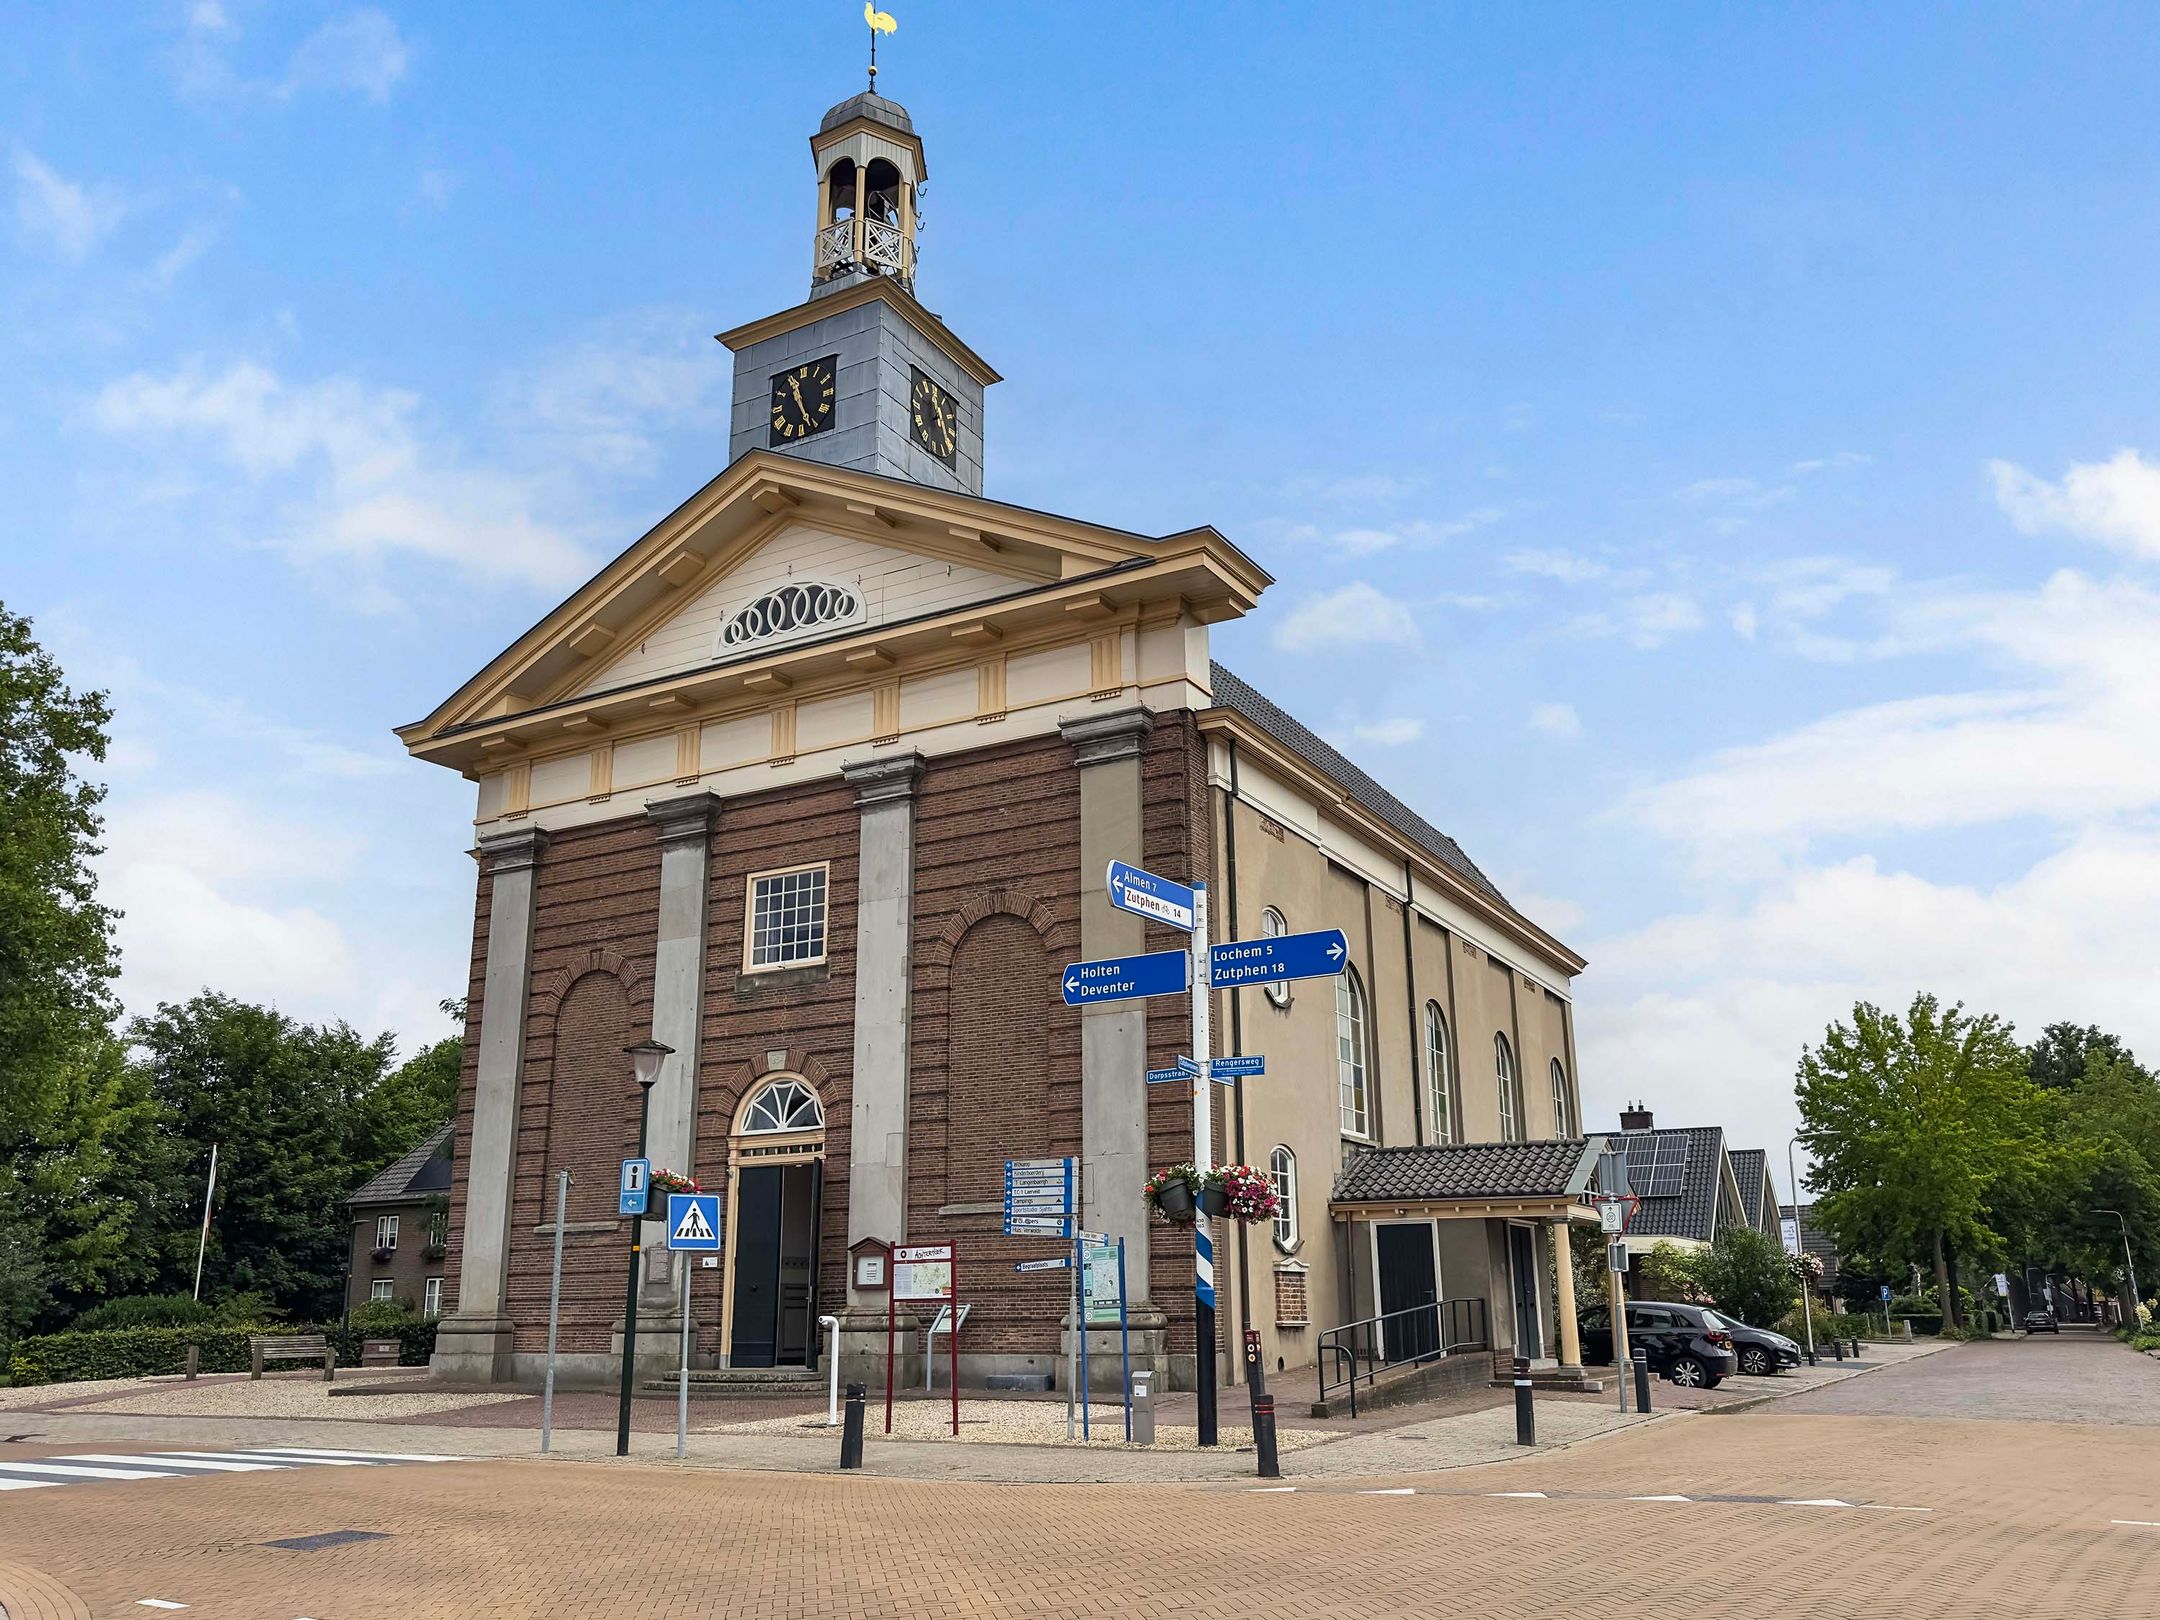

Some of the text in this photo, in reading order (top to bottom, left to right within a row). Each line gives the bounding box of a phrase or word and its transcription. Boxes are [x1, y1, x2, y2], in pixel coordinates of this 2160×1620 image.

[1124, 871, 1157, 892] Almen 7
[1126, 890, 1181, 918] Zutphen 14
[1214, 946, 1272, 961] Lochem 5
[1081, 966, 1120, 979] Holten
[1215, 963, 1285, 980] Zutphen 18
[1081, 982, 1135, 996] Deventer
[1216, 1058, 1259, 1068] Rengersweg
